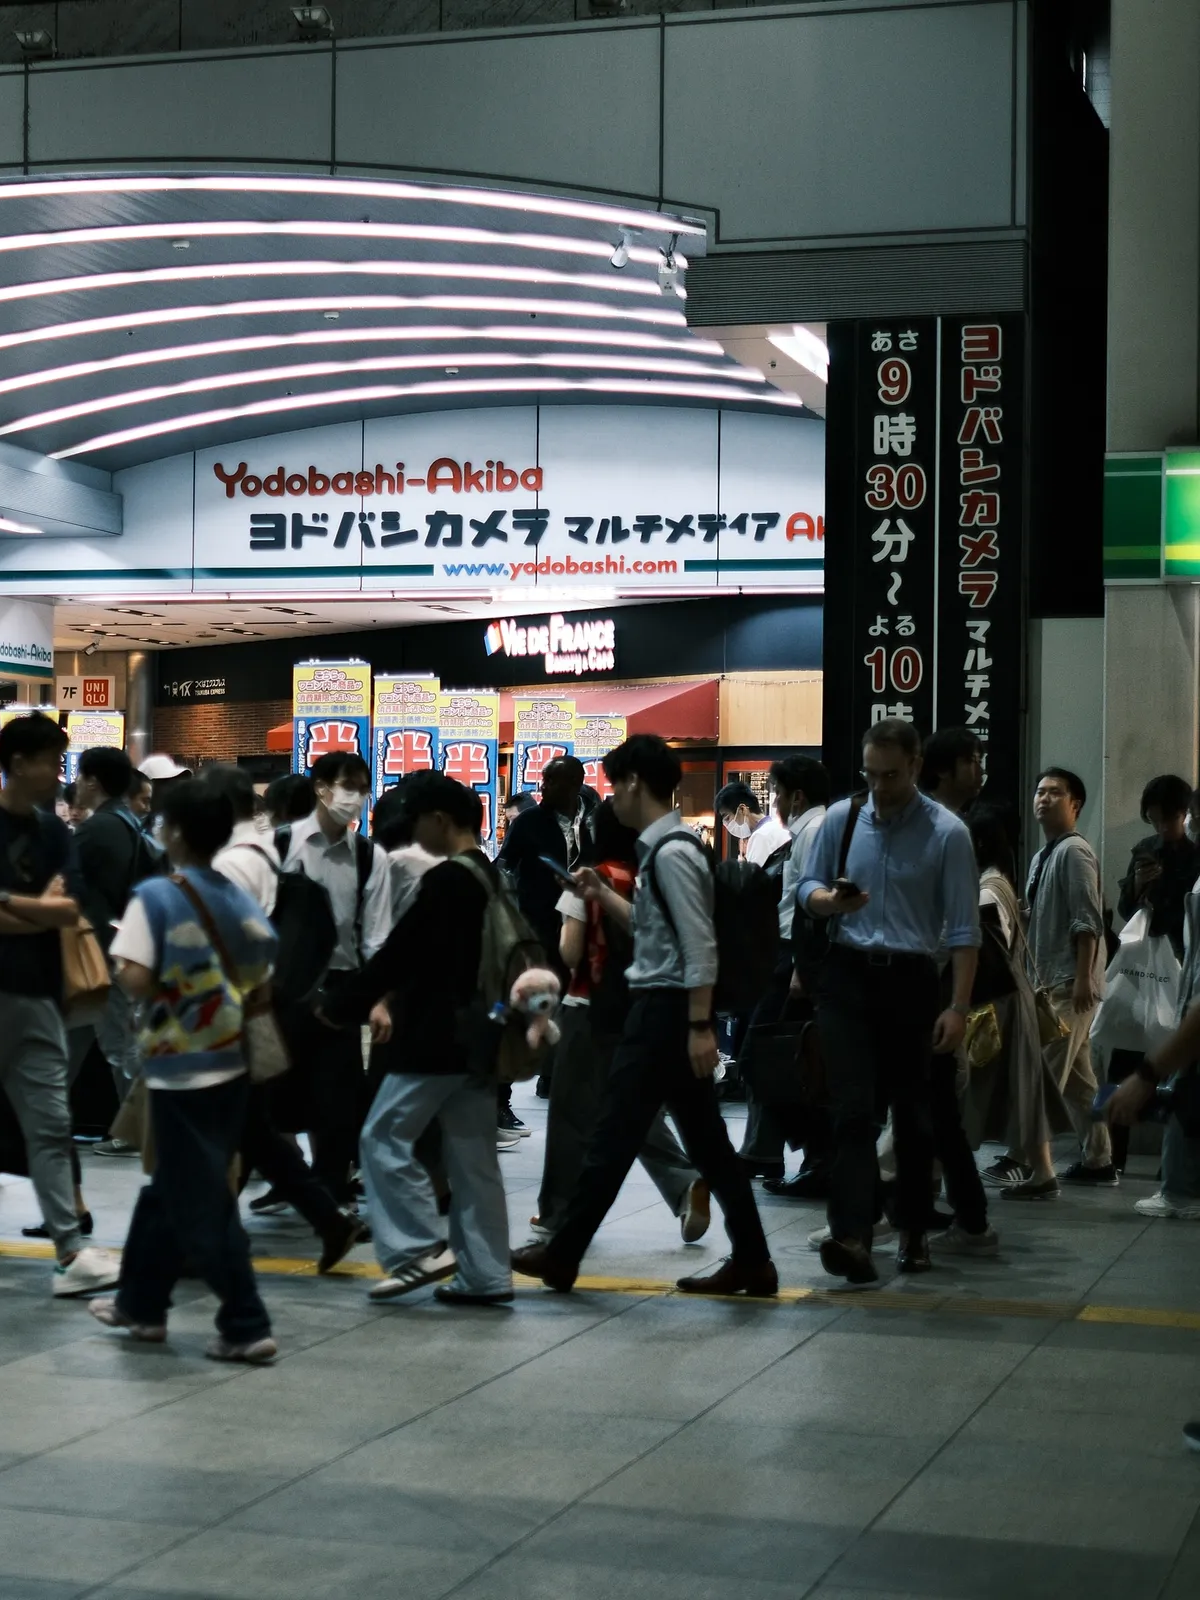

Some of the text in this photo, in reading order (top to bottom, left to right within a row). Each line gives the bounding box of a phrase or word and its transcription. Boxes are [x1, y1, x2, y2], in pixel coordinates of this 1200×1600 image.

[957, 324, 1003, 608] ヨドバシカメラ
[214, 457, 543, 499] Yodobashi-Akiba
[249, 508, 550, 550] ヨドバシカメラ
[563, 511, 781, 543] マルチメディア
[442, 556, 678, 581] www.yodobashi.com
[314, 669, 347, 681] こちらの
[62, 687, 77, 698] 7F
[86, 682, 105, 692] UNI
[393, 683, 422, 694] こちらの
[86, 693, 106, 703] QLO
